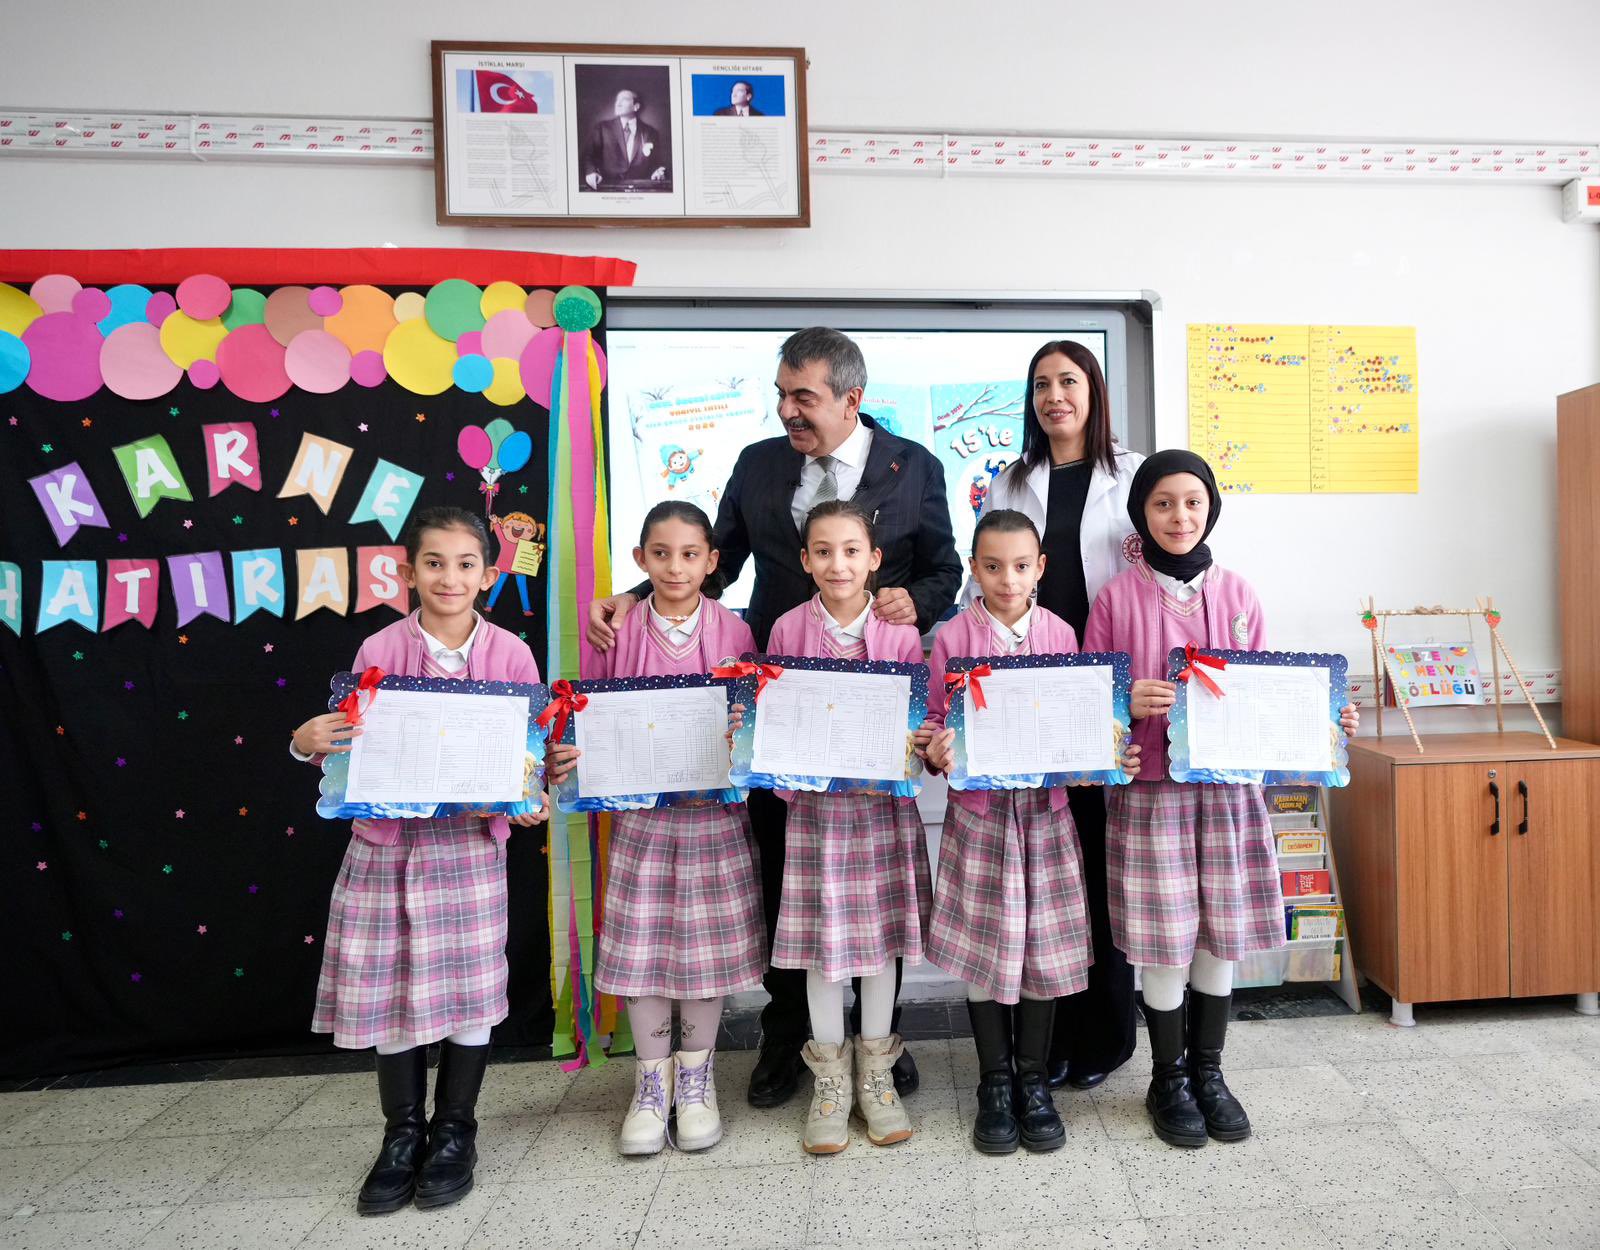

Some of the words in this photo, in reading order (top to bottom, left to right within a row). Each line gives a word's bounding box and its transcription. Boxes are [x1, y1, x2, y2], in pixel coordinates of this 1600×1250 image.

[950, 425, 1013, 458] 15'te
[44, 430, 412, 527] KARNE
[1396, 651, 1441, 665] SEBZE
[1416, 665, 1465, 676] MEYVE
[1399, 680, 1475, 698] SÖZLÜĞÜ
